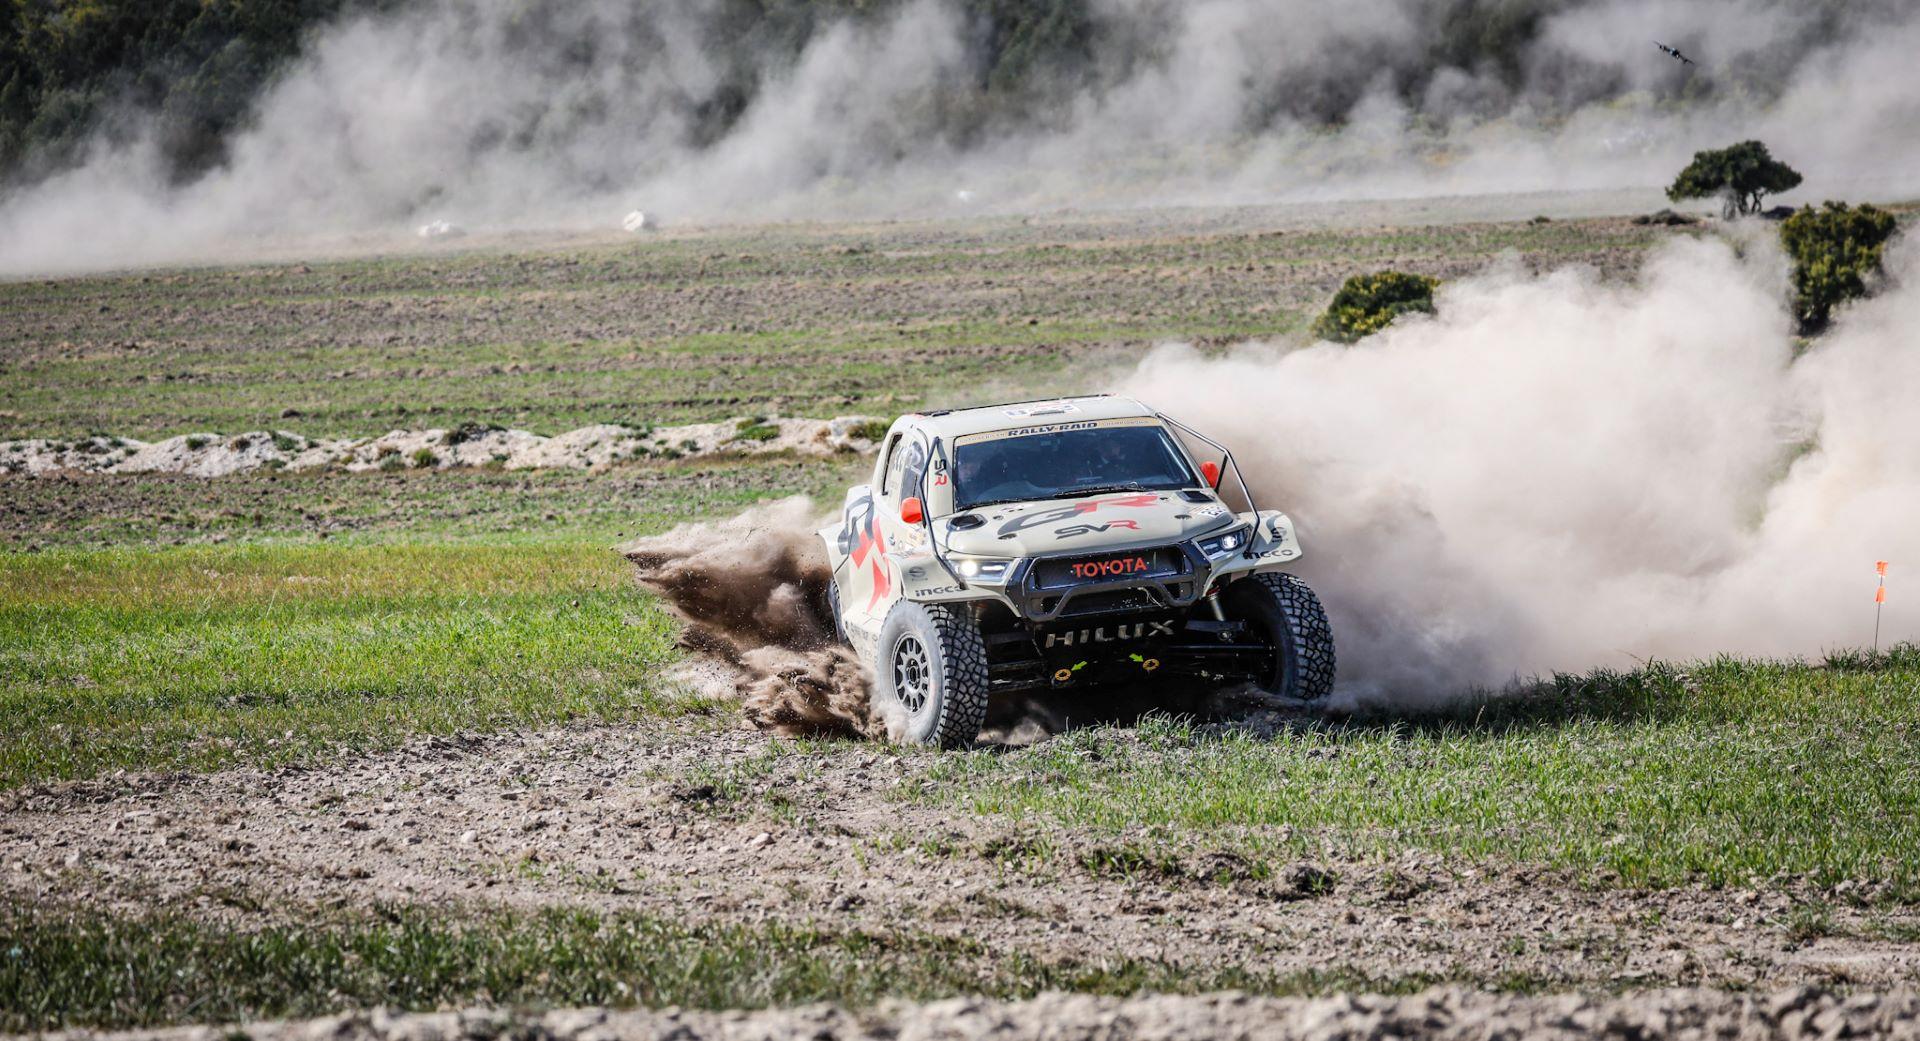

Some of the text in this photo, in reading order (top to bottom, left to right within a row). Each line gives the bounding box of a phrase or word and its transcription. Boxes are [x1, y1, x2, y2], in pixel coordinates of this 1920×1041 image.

[934, 459, 948, 486] SVR
[1054, 519, 1143, 541] SVR
[1072, 556, 1148, 578] TOYOTA
[1045, 619, 1175, 649] HILUX
